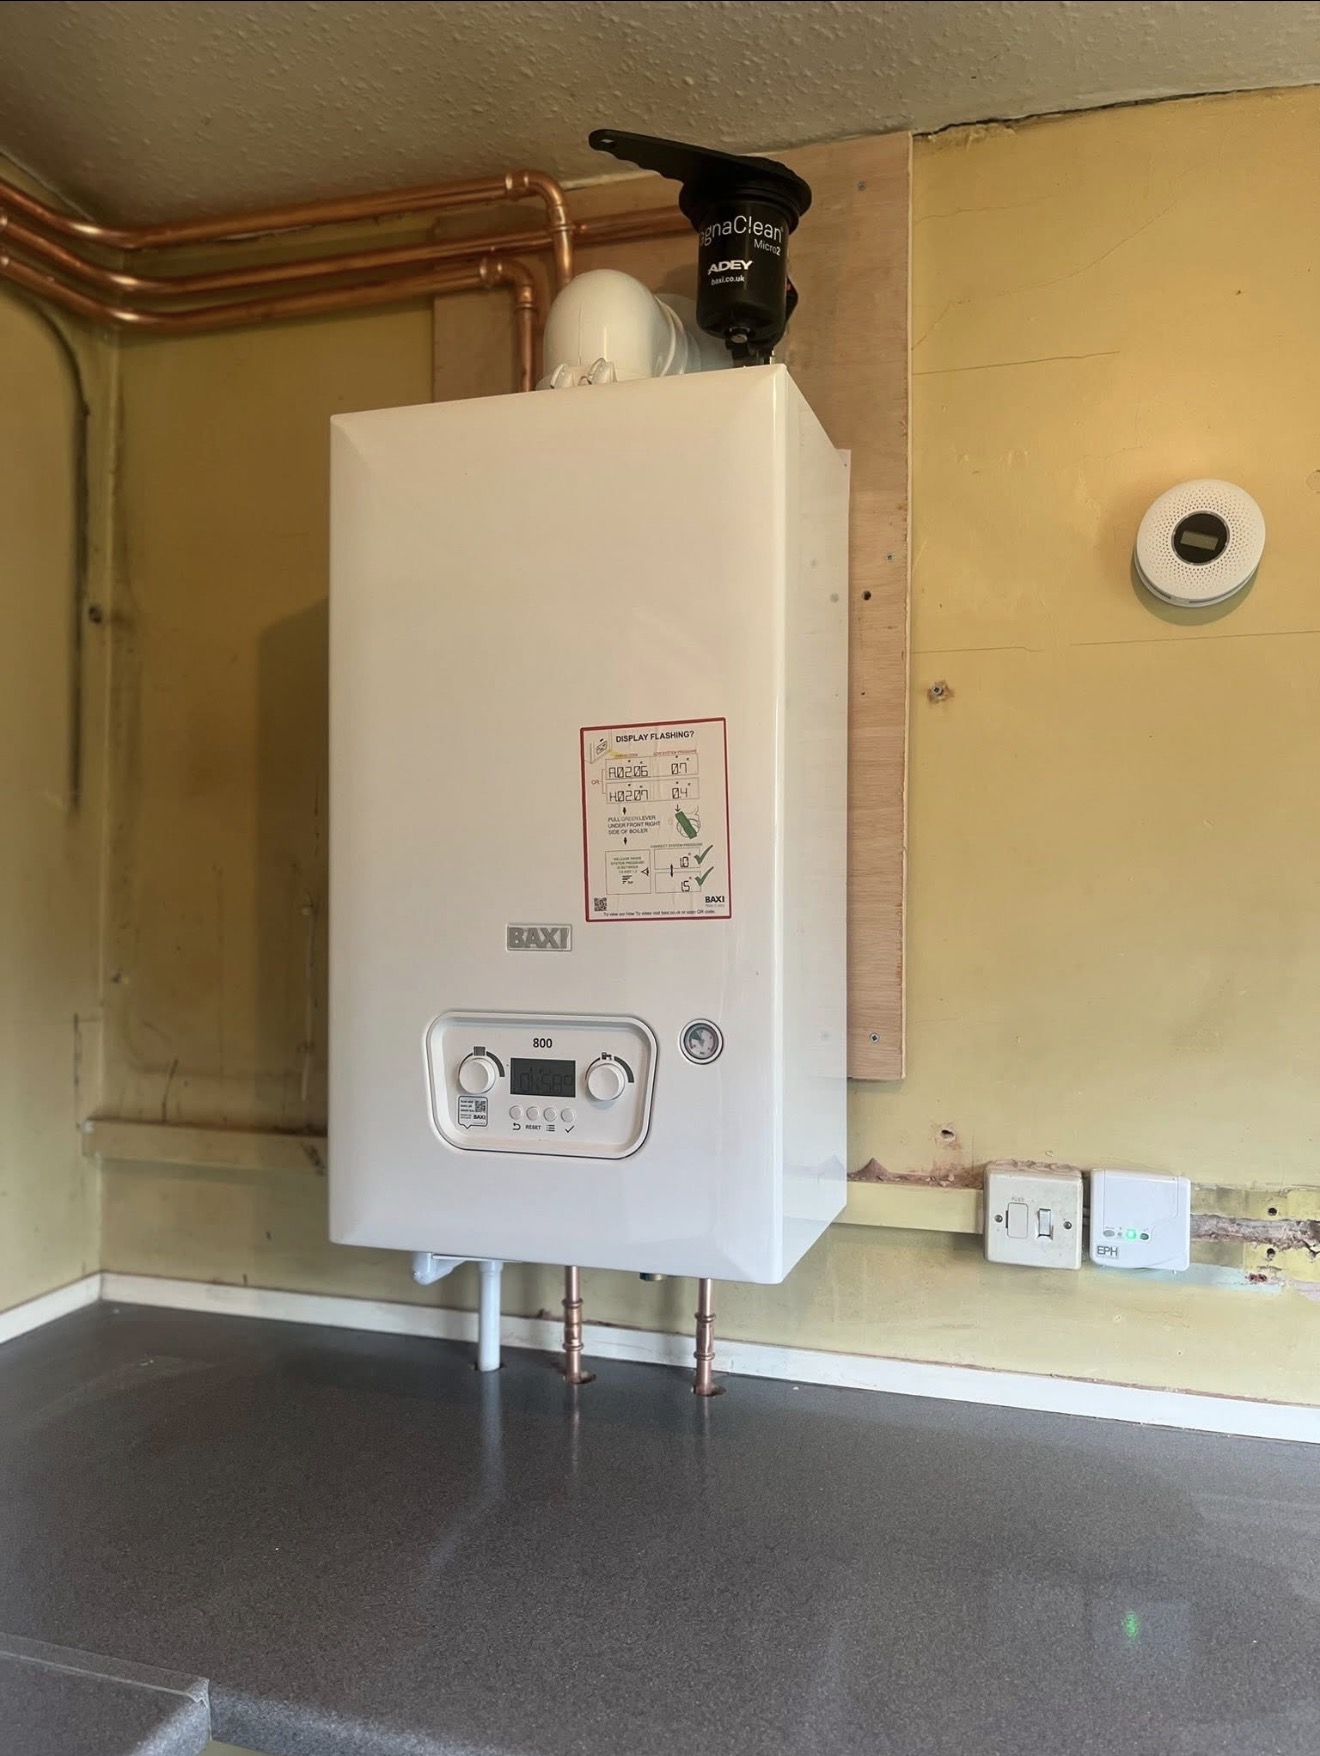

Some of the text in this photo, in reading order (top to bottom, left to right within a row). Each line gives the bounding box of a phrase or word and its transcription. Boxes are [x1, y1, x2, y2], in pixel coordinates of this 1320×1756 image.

[754, 238, 781, 256] Micro2
[708, 260, 753, 275] ADEY
[616, 730, 694, 743] DISPLAY FLASHING?
[705, 895, 725, 903] BAXI
[508, 927, 568, 949] BAXI
[533, 1038, 552, 1048] 800
[1097, 1245, 1118, 1257] EPH
